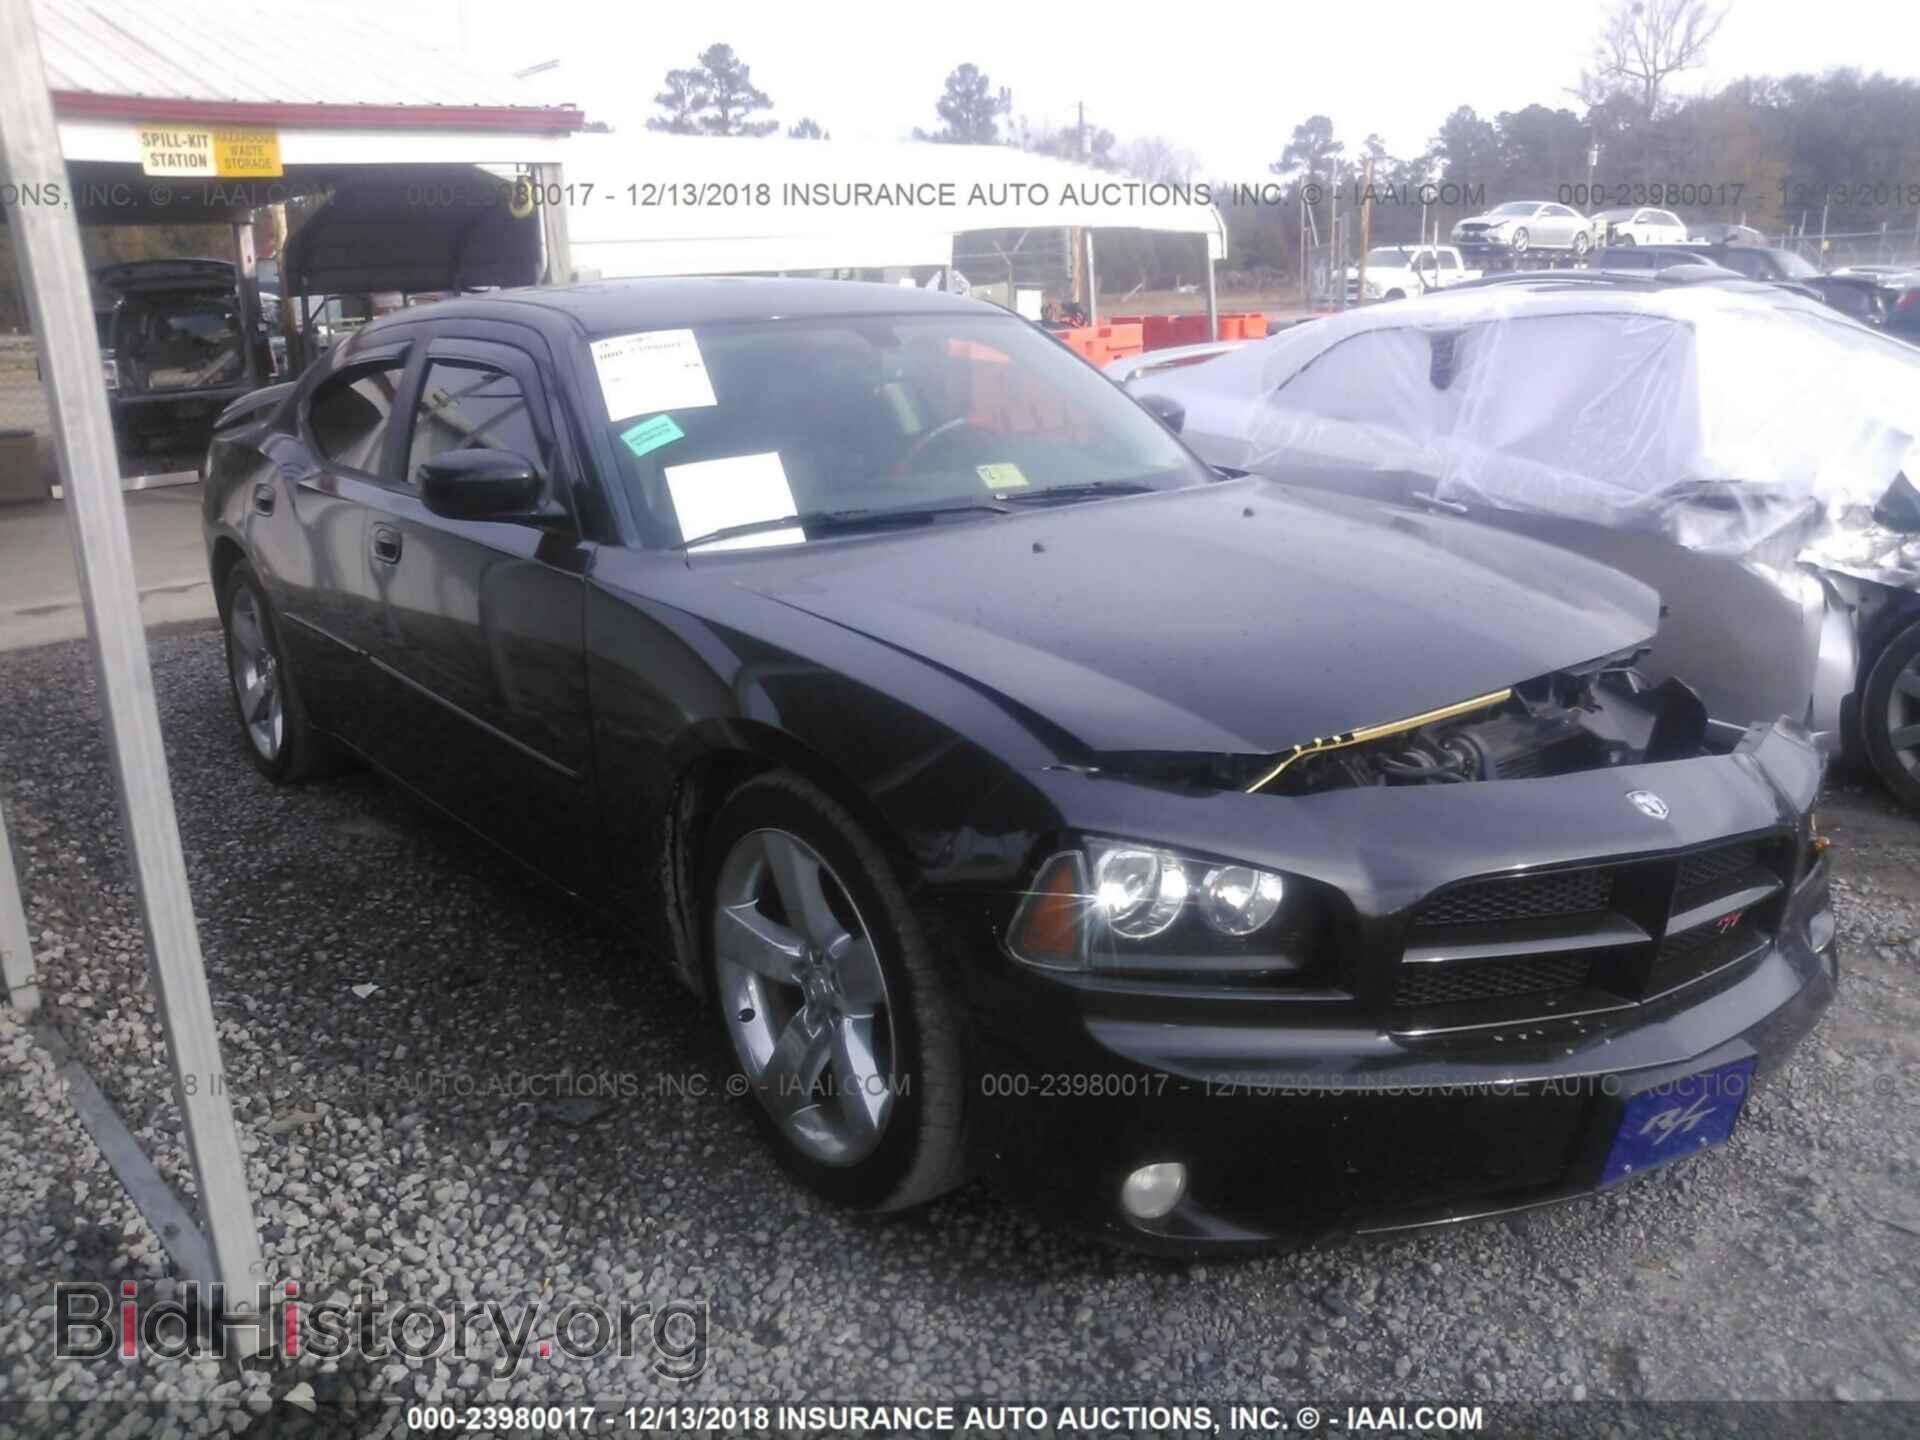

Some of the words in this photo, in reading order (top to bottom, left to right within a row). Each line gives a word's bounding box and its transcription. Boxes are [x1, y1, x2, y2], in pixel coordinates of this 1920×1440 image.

[141, 131, 209, 149] SPILL-KIT
[229, 144, 265, 156] WASTE
[150, 152, 208, 169] STATION
[224, 157, 272, 170] STORAGE
